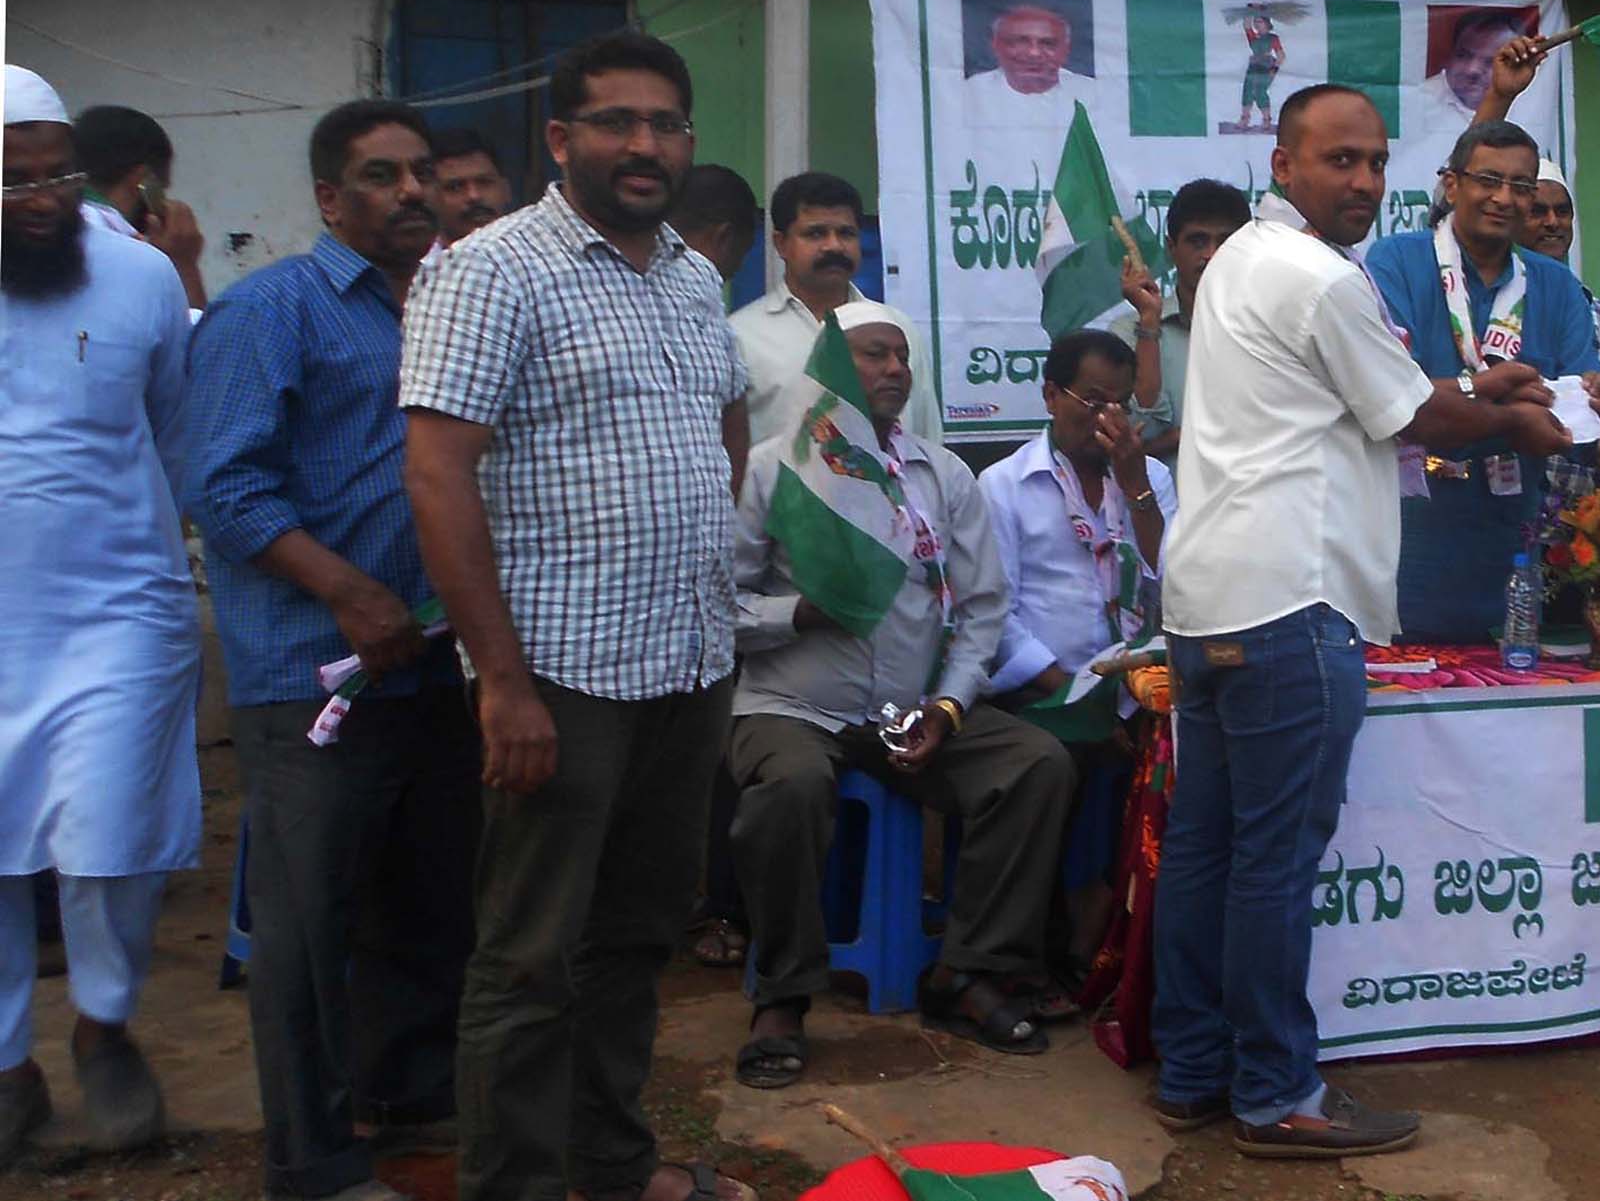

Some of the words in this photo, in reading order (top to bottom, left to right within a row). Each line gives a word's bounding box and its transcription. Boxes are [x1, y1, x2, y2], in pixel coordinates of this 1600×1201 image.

[949, 159, 1056, 270] ಕೊಡ
[1311, 845, 1405, 928] ಡಗು
[1434, 856, 1545, 940] ಜಿಲ್ಲಾ
[1342, 952, 1587, 1008] ವಿರಾಜಪೇಟೆ
